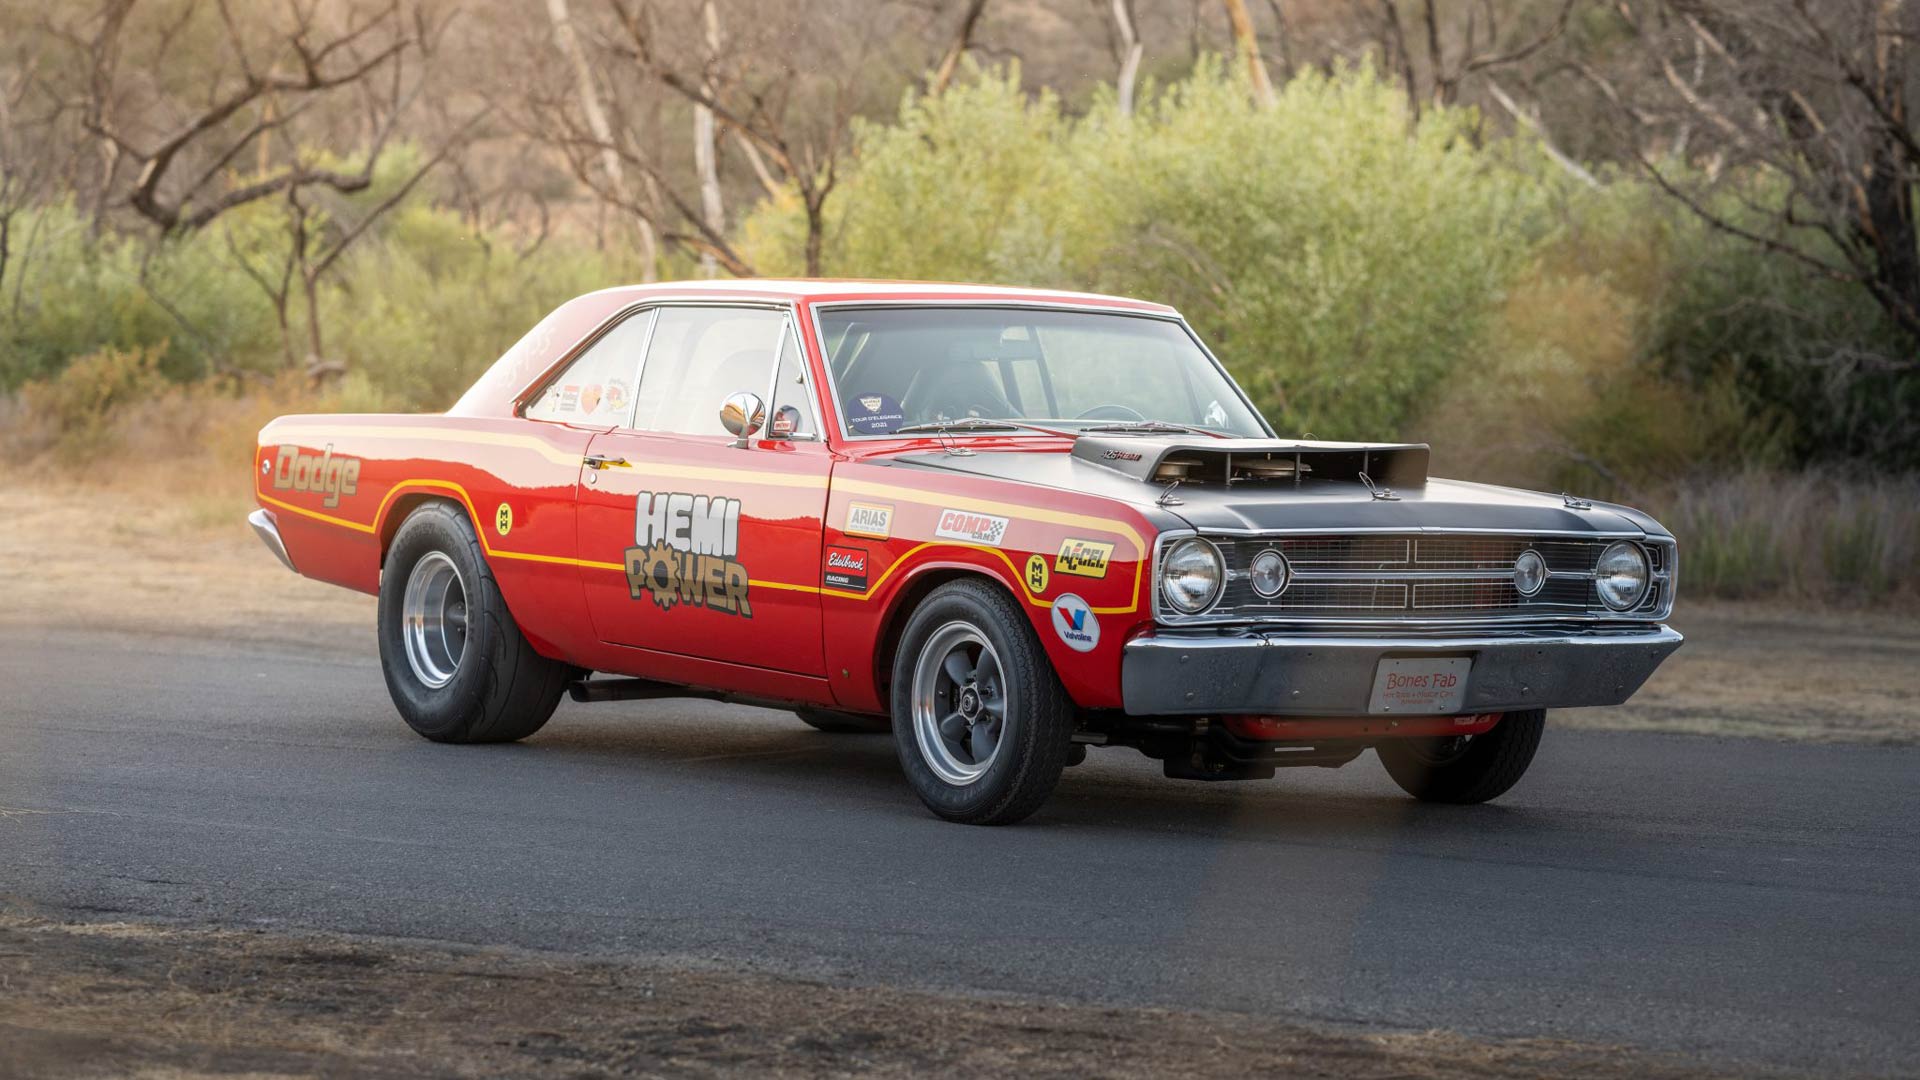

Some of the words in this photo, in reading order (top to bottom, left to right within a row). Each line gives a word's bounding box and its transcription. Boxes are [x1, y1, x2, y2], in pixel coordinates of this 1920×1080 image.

[273, 443, 361, 508] Dodge
[635, 490, 741, 557] HEMI
[851, 508, 887, 527] ARIAS
[940, 512, 992, 534] COMP
[971, 531, 997, 542] CAMS
[828, 552, 864, 571] Edelbrock
[1059, 542, 1105, 571] ACCEL
[624, 539, 752, 618] POWER
[826, 574, 849, 583] RACING
[1063, 630, 1093, 643] Valvoline
[1386, 672, 1429, 690] Bones
[1432, 672, 1457, 689] Fab
